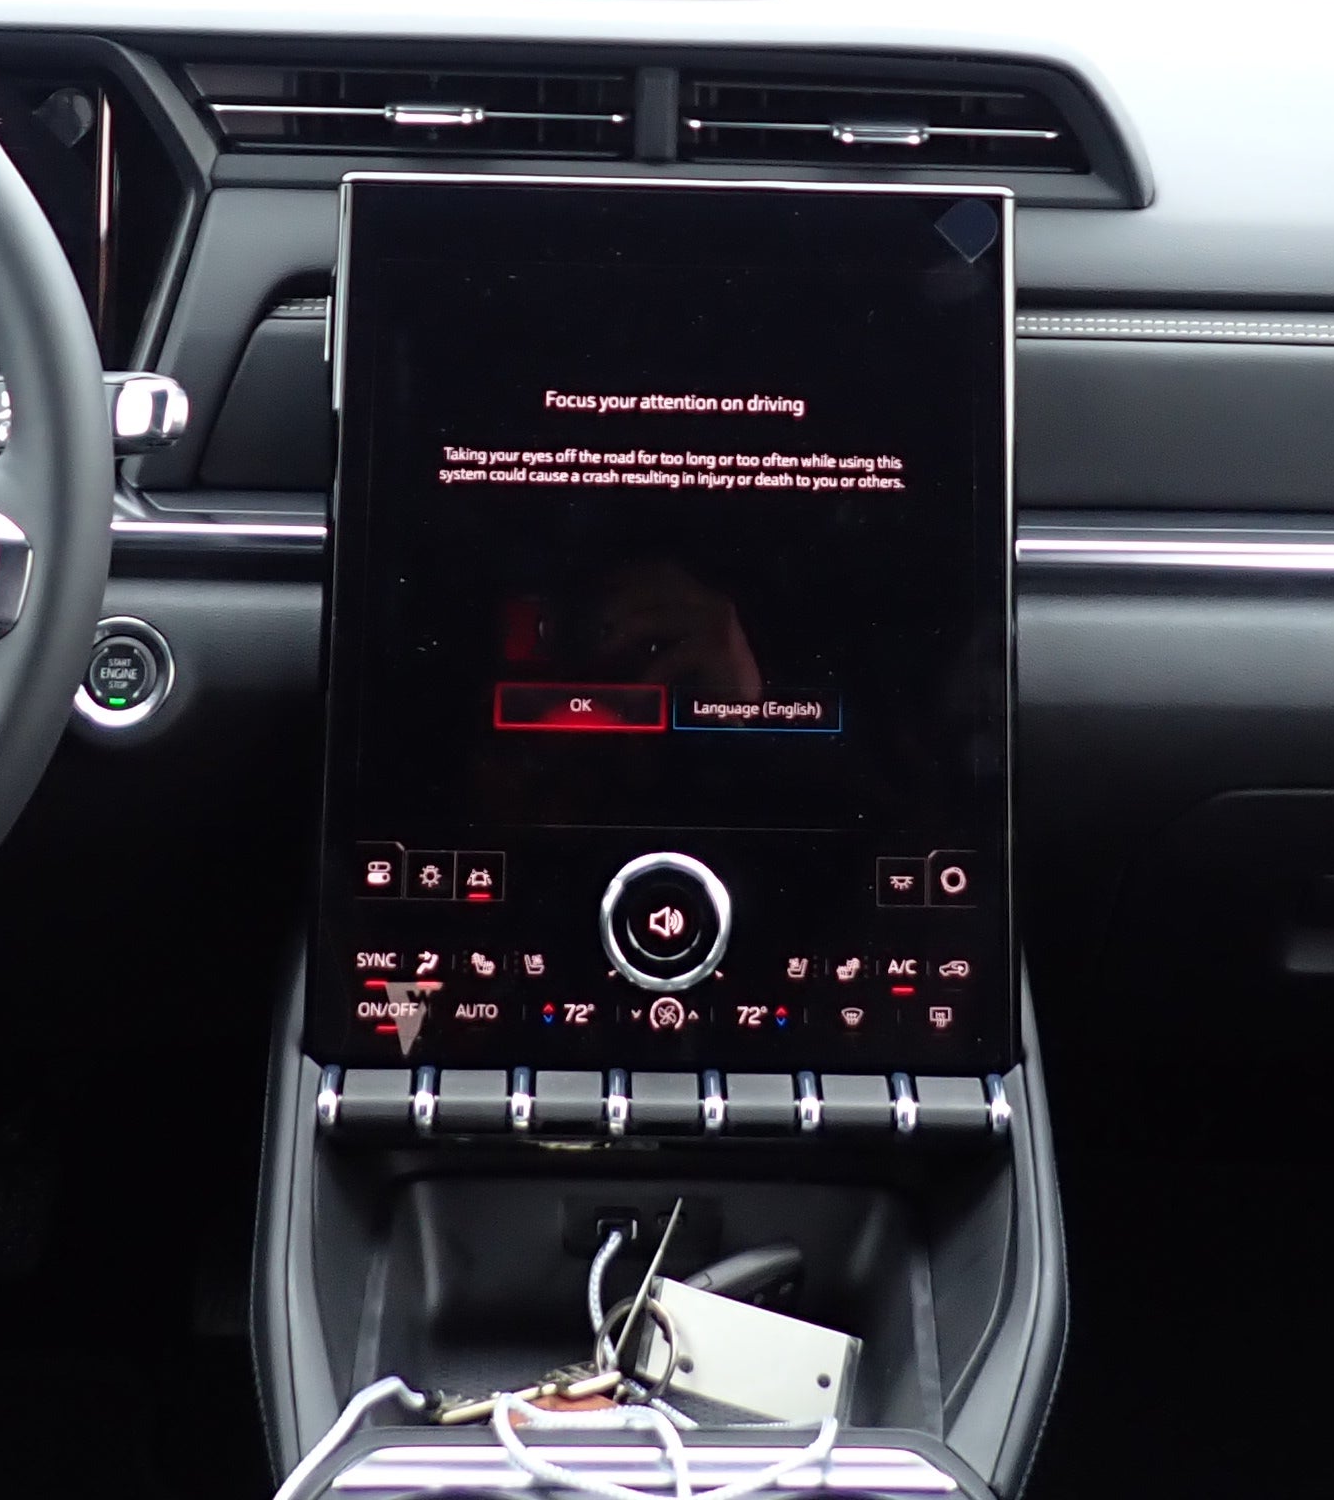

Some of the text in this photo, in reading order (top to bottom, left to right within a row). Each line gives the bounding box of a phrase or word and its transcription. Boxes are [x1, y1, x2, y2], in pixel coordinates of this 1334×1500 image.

[546, 389, 805, 417] Focus your attention on driving
[443, 446, 903, 472] Taking your eyes off the road for too long or too often while using this
[439, 467, 906, 490] system could cause a crash resulting in injury or death to you or others.
[108, 658, 132, 667] START
[99, 667, 138, 681] ENGINE
[569, 698, 593, 712] OK
[693, 700, 823, 720] Language (English)
[356, 952, 397, 968] SYNC
[887, 959, 917, 975] A/C
[357, 1002, 419, 1017] ON/OFF
[454, 1003, 499, 1019] AUTO
[563, 1003, 596, 1023] 72°
[736, 1005, 768, 1025] 72°
